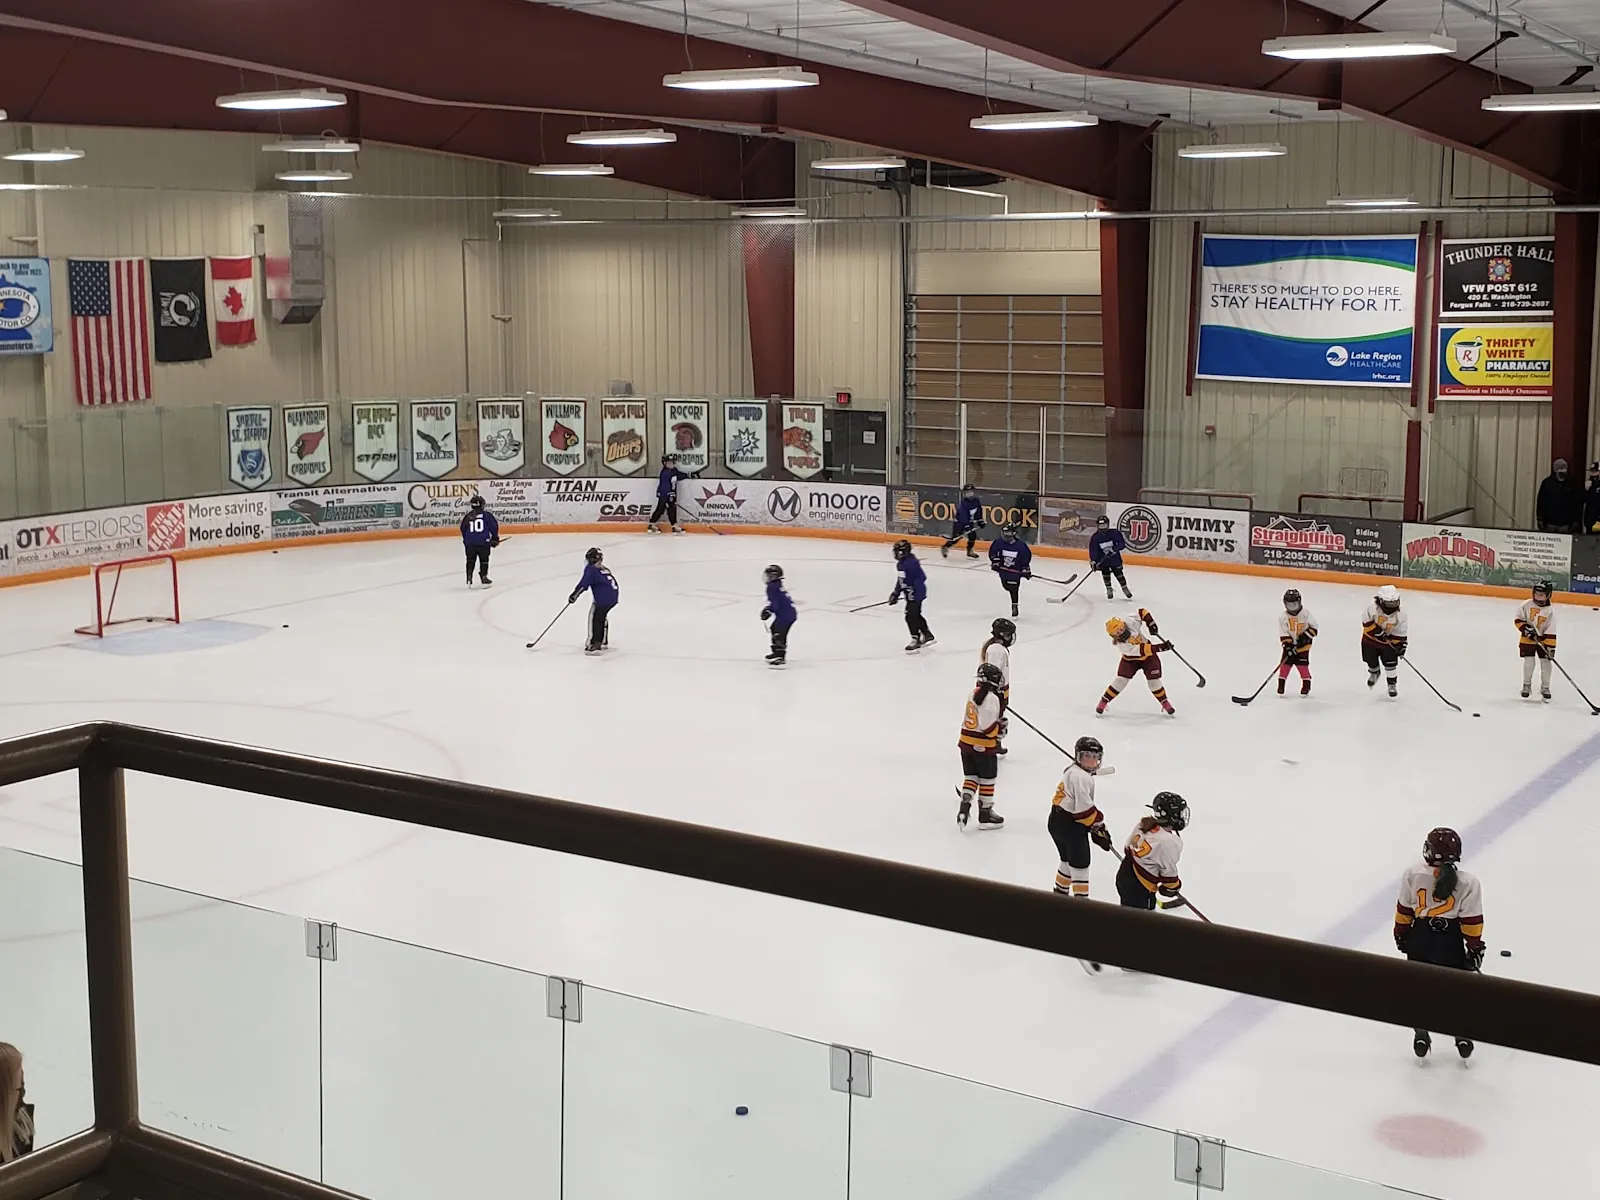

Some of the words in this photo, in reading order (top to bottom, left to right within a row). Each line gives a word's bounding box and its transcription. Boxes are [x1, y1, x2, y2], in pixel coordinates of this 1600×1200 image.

[1445, 245, 1512, 265] THUNDER
[1517, 245, 1554, 263] HALL
[1211, 284, 1257, 294] THERE'S
[1262, 285, 1277, 294] SO
[1281, 286, 1319, 296] MUCH
[1321, 286, 1339, 296] TO
[1344, 286, 1364, 296] DO
[1368, 287, 1402, 296] HERE.
[1462, 284, 1485, 293] VFW
[1487, 284, 1516, 292] POST
[1518, 284, 1538, 292] 612
[1210, 296, 1250, 308] STAY
[1255, 297, 1335, 311] HEALTHY
[1342, 298, 1378, 311] FOR
[1384, 299, 1402, 312] IT.
[1491, 294, 1532, 302] Washington
[1486, 339, 1536, 348] THRIFTY
[1351, 352, 1370, 360] Lake
[1373, 352, 1402, 362] Region
[1486, 350, 1524, 358] WHITE
[1486, 362, 1549, 370] PHARMACY
[1372, 373, 1401, 381] lrhc.org
[1503, 372, 1528, 380] Employee
[1490, 388, 1514, 396] Healthy
[417, 406, 452, 420] APOLLO
[546, 404, 582, 419] WILLMAR
[670, 406, 704, 420] ROCORI
[288, 410, 326, 426] ALEXANDRIA
[416, 451, 454, 460] EAGLES
[607, 439, 642, 462] Otters
[546, 454, 580, 465] CARDINALS
[674, 454, 704, 466] PARTANS
[291, 462, 326, 475] CARDINALS
[513, 480, 532, 488] Tonya
[546, 480, 598, 492] TITAN
[276, 489, 320, 498] Transit
[323, 486, 397, 496] Alternatives
[408, 484, 479, 511] CULLEN'S
[556, 494, 628, 502] MACHINERY
[430, 498, 451, 508] Home
[809, 492, 880, 511] moore
[188, 503, 222, 519] More
[224, 498, 267, 516] saving.
[322, 505, 377, 521] EXPRESS
[600, 504, 652, 516] CASE
[152, 510, 166, 530] THE
[867, 513, 882, 523] inc.
[16, 514, 144, 548] OTXTERIORS
[148, 503, 185, 552] HOME
[469, 519, 484, 532] 10
[1130, 520, 1150, 542] JJ
[1166, 516, 1235, 534] JIMMY
[190, 525, 222, 542] More
[226, 522, 264, 539] doing.
[1252, 527, 1345, 546] Straightline
[1356, 528, 1379, 538] Siding
[1166, 534, 1235, 552] JOHN'S
[1352, 538, 1382, 549] Roofing
[1264, 550, 1332, 562] 218-205-7803
[1345, 548, 1388, 560] Remodeling
[1406, 536, 1495, 570] WOLDEN
[1334, 558, 1350, 566] New
[1350, 560, 1398, 570] Construction
